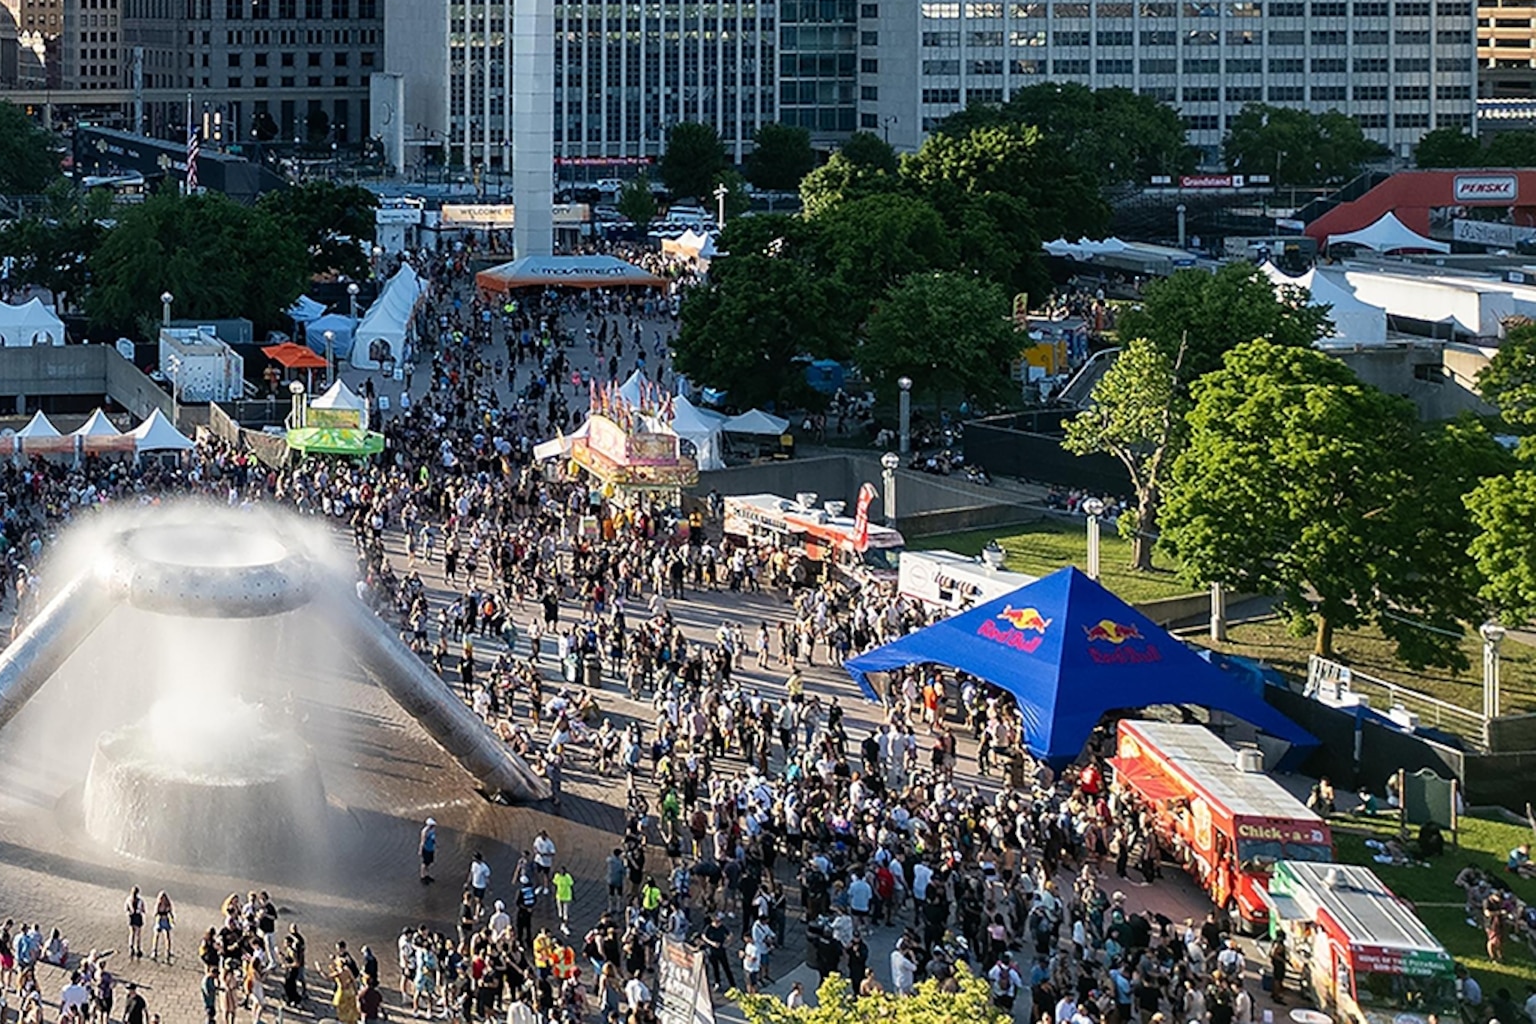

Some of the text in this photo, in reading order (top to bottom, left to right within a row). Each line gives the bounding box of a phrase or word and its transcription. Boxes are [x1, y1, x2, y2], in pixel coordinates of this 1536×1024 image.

[1183, 176, 1231, 187] Grandstand
[1460, 182, 1511, 193] PENSKE
[459, 208, 503, 216] WELCOME
[977, 618, 1043, 653] Red Bull
[1088, 644, 1162, 664] Red Bull
